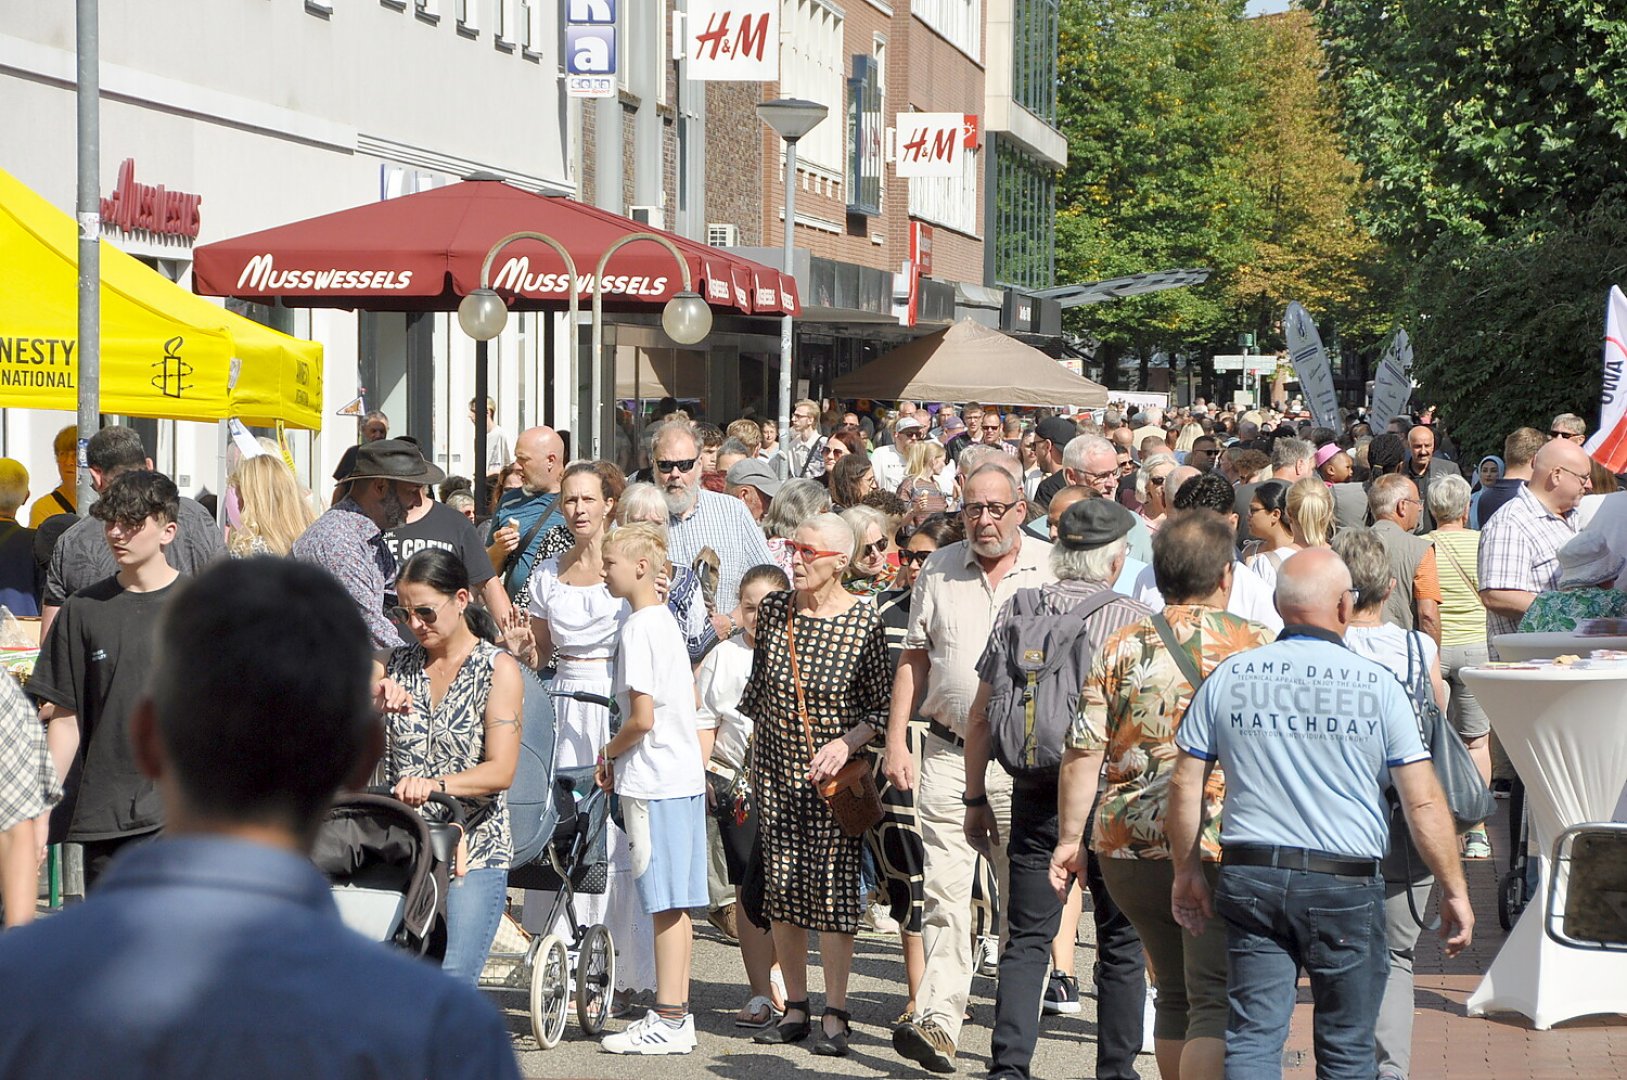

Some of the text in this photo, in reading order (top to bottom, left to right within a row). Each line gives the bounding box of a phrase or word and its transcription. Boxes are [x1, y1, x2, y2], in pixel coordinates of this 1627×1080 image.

[696, 11, 769, 62] H&M
[902, 127, 957, 163] H&M
[2, 369, 75, 388] NATIONAL
[1231, 661, 1378, 684] CAMP DAVID
[1230, 682, 1380, 718] SUCCEED
[1230, 712, 1379, 735] MATCHDAY
